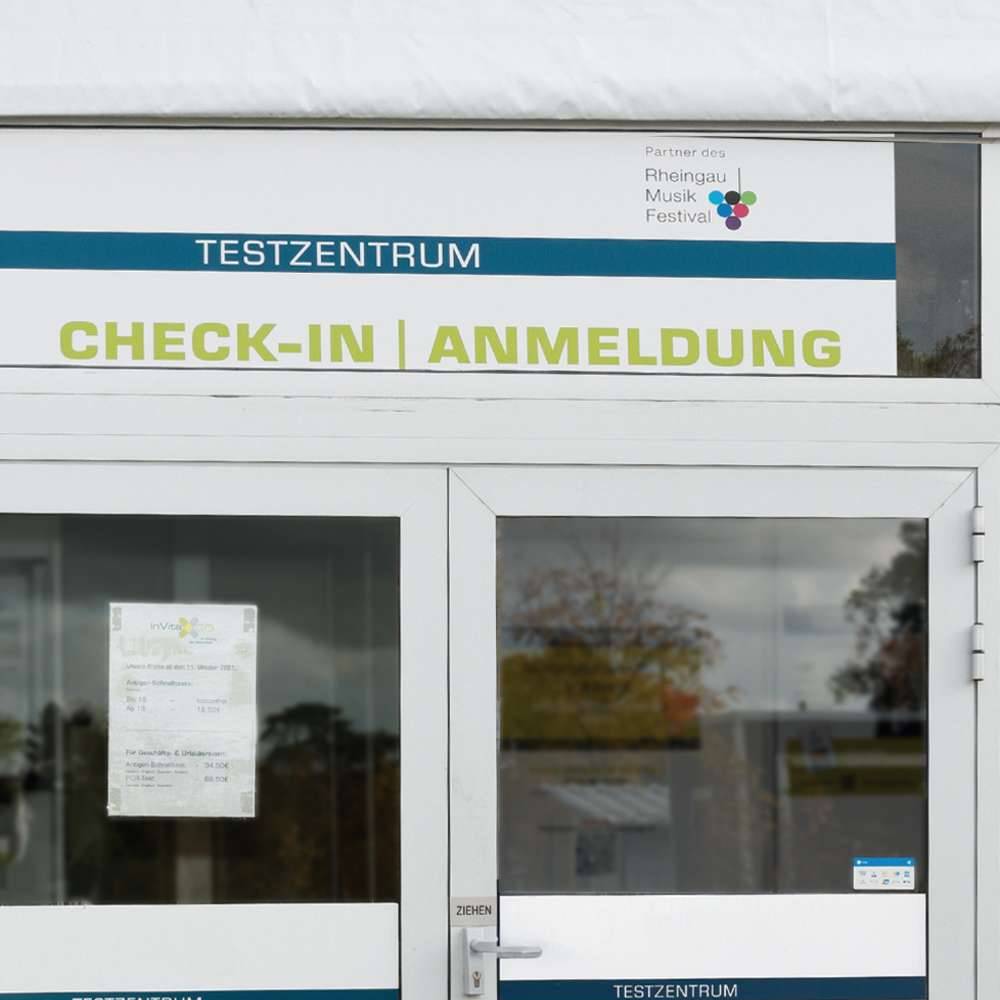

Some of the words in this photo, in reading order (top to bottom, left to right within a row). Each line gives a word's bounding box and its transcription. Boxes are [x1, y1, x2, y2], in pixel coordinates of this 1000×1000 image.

[645, 146, 697, 158] Partner
[701, 149, 726, 158] des
[645, 168, 727, 185] Rheingau
[645, 188, 697, 203] Musik
[646, 208, 712, 223] Festival
[195, 239, 481, 269] TESTZENTRUM
[59, 320, 375, 363] CHECK-IN
[428, 324, 843, 369] ANMELDUNG
[456, 905, 492, 916] ZIEHEN
[613, 984, 738, 999] TESTZENTRUM
